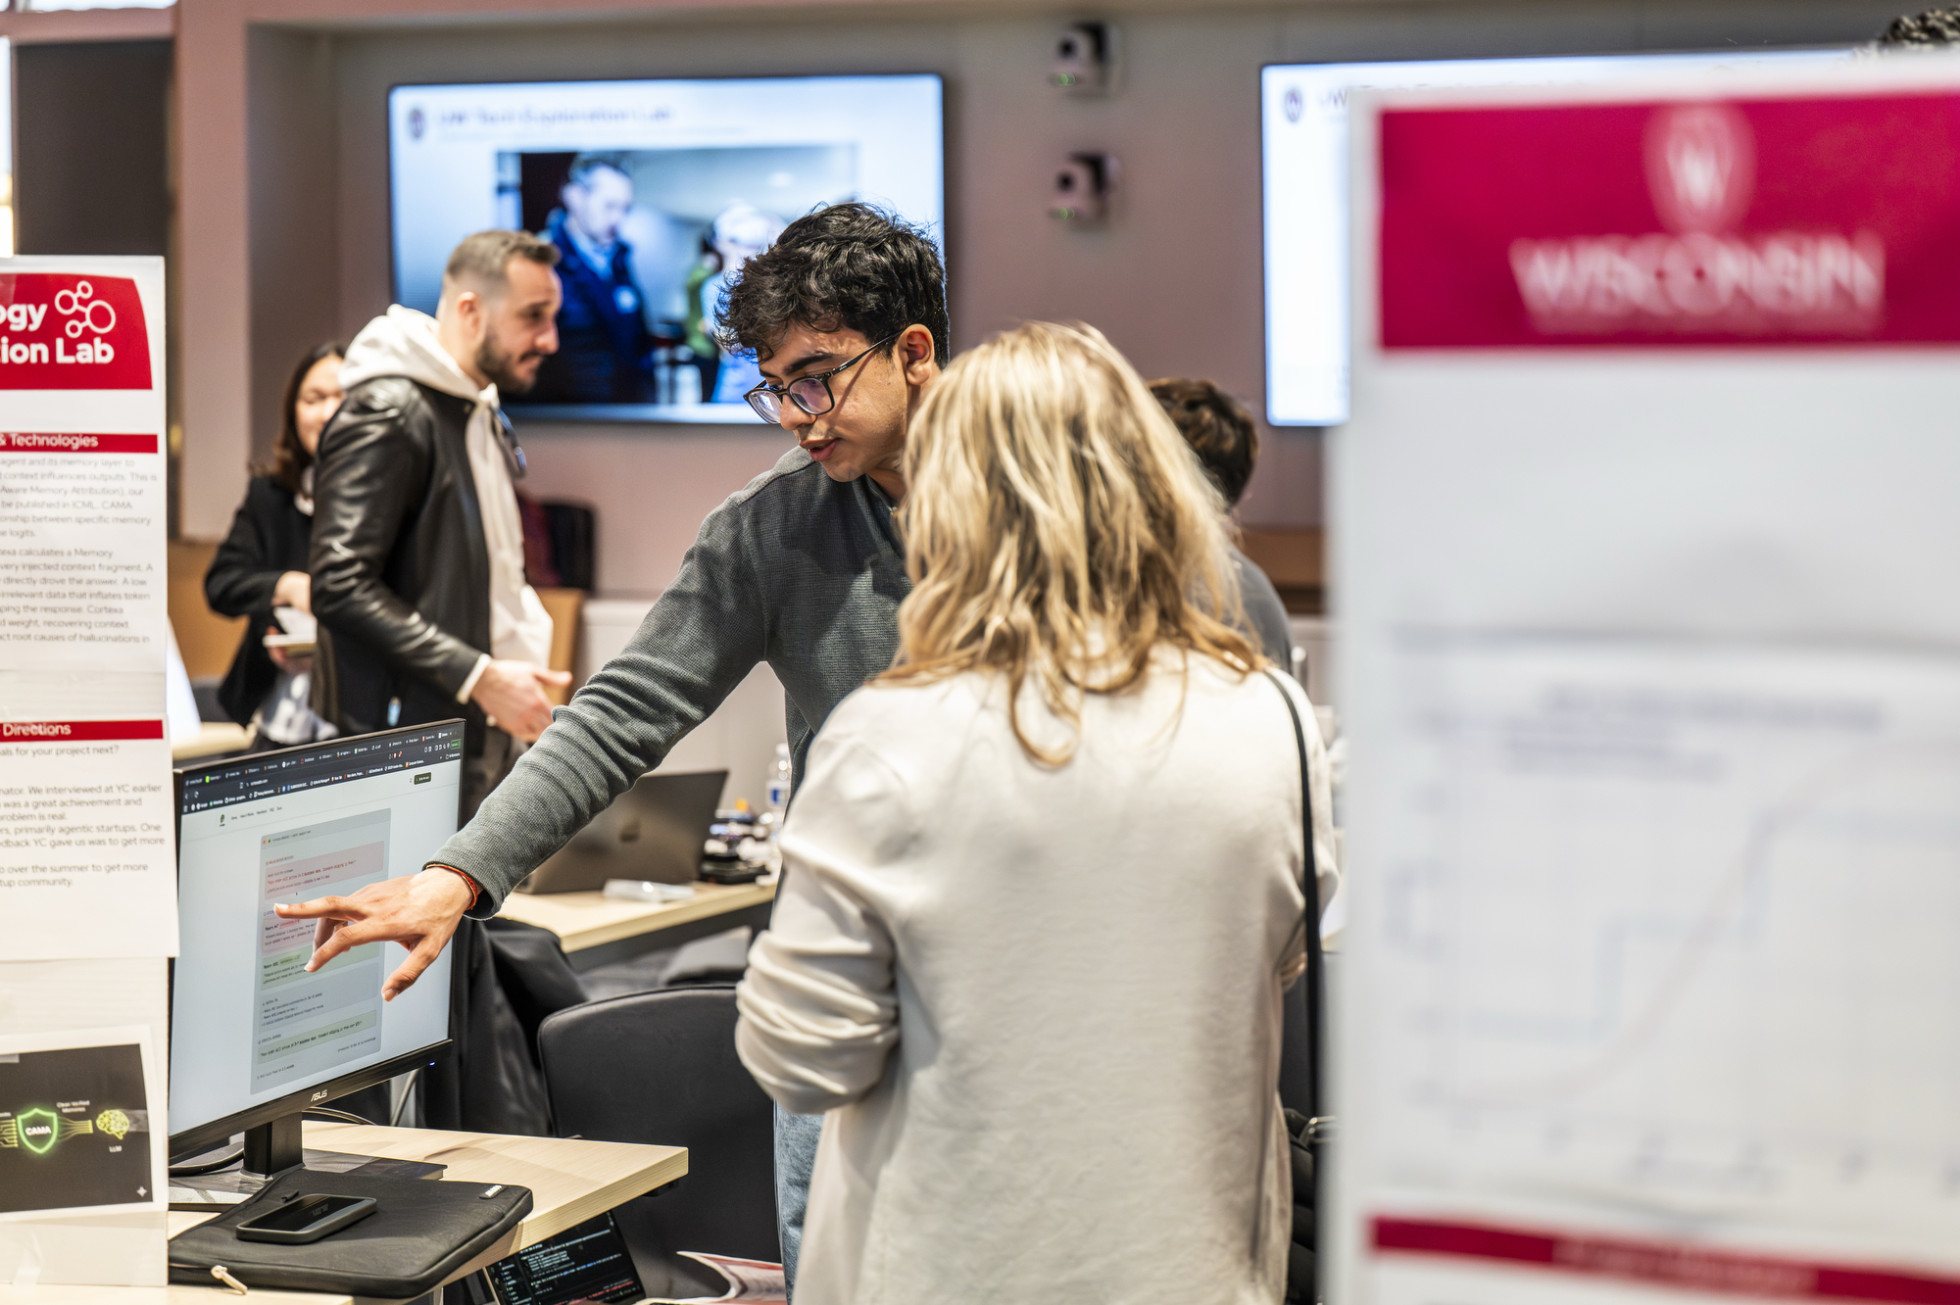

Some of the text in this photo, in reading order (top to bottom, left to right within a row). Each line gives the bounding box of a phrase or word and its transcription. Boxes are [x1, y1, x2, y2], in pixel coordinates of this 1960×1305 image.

[1510, 232, 1884, 316] WISCONSIN
[55, 337, 115, 364] Lab
[10, 433, 99, 450] Technologies
[29, 458, 46, 466] and
[102, 501, 133, 510] CAMA
[19, 548, 64, 556] calculates
[75, 549, 113, 559] Memory
[40, 577, 66, 585] drove
[68, 577, 84, 585] the
[46, 590, 66, 598] data
[68, 591, 87, 599] that
[22, 604, 37, 613] the
[94, 620, 128, 628] context
[13, 633, 31, 641] root
[34, 634, 65, 642] causes
[3, 723, 72, 737] Directions
[15, 746, 28, 755] for
[31, 748, 52, 758] your
[55, 747, 90, 757] project
[92, 745, 119, 754] next?
[28, 786, 43, 794] We
[46, 785, 102, 794] interviewed
[104, 785, 114, 793] at
[115, 784, 130, 793] YC
[132, 784, 161, 793] earlier
[32, 799, 57, 810] great
[59, 798, 121, 808] achievement
[124, 798, 142, 806] and
[14, 824, 56, 836] primarily
[58, 824, 93, 835] agentic
[141, 823, 161, 832] One
[33, 838, 47, 847] YC
[49, 839, 73, 850] gave
[88, 838, 106, 846] was
[108, 837, 119, 845] to
[121, 837, 137, 847] get
[31, 864, 48, 873] the
[50, 864, 89, 872] summer
[92, 863, 102, 872] to
[104, 864, 121, 874] get
[123, 863, 148, 871] more
[311, 1089, 328, 1102] ASUS
[25, 1126, 51, 1136] CAMA
